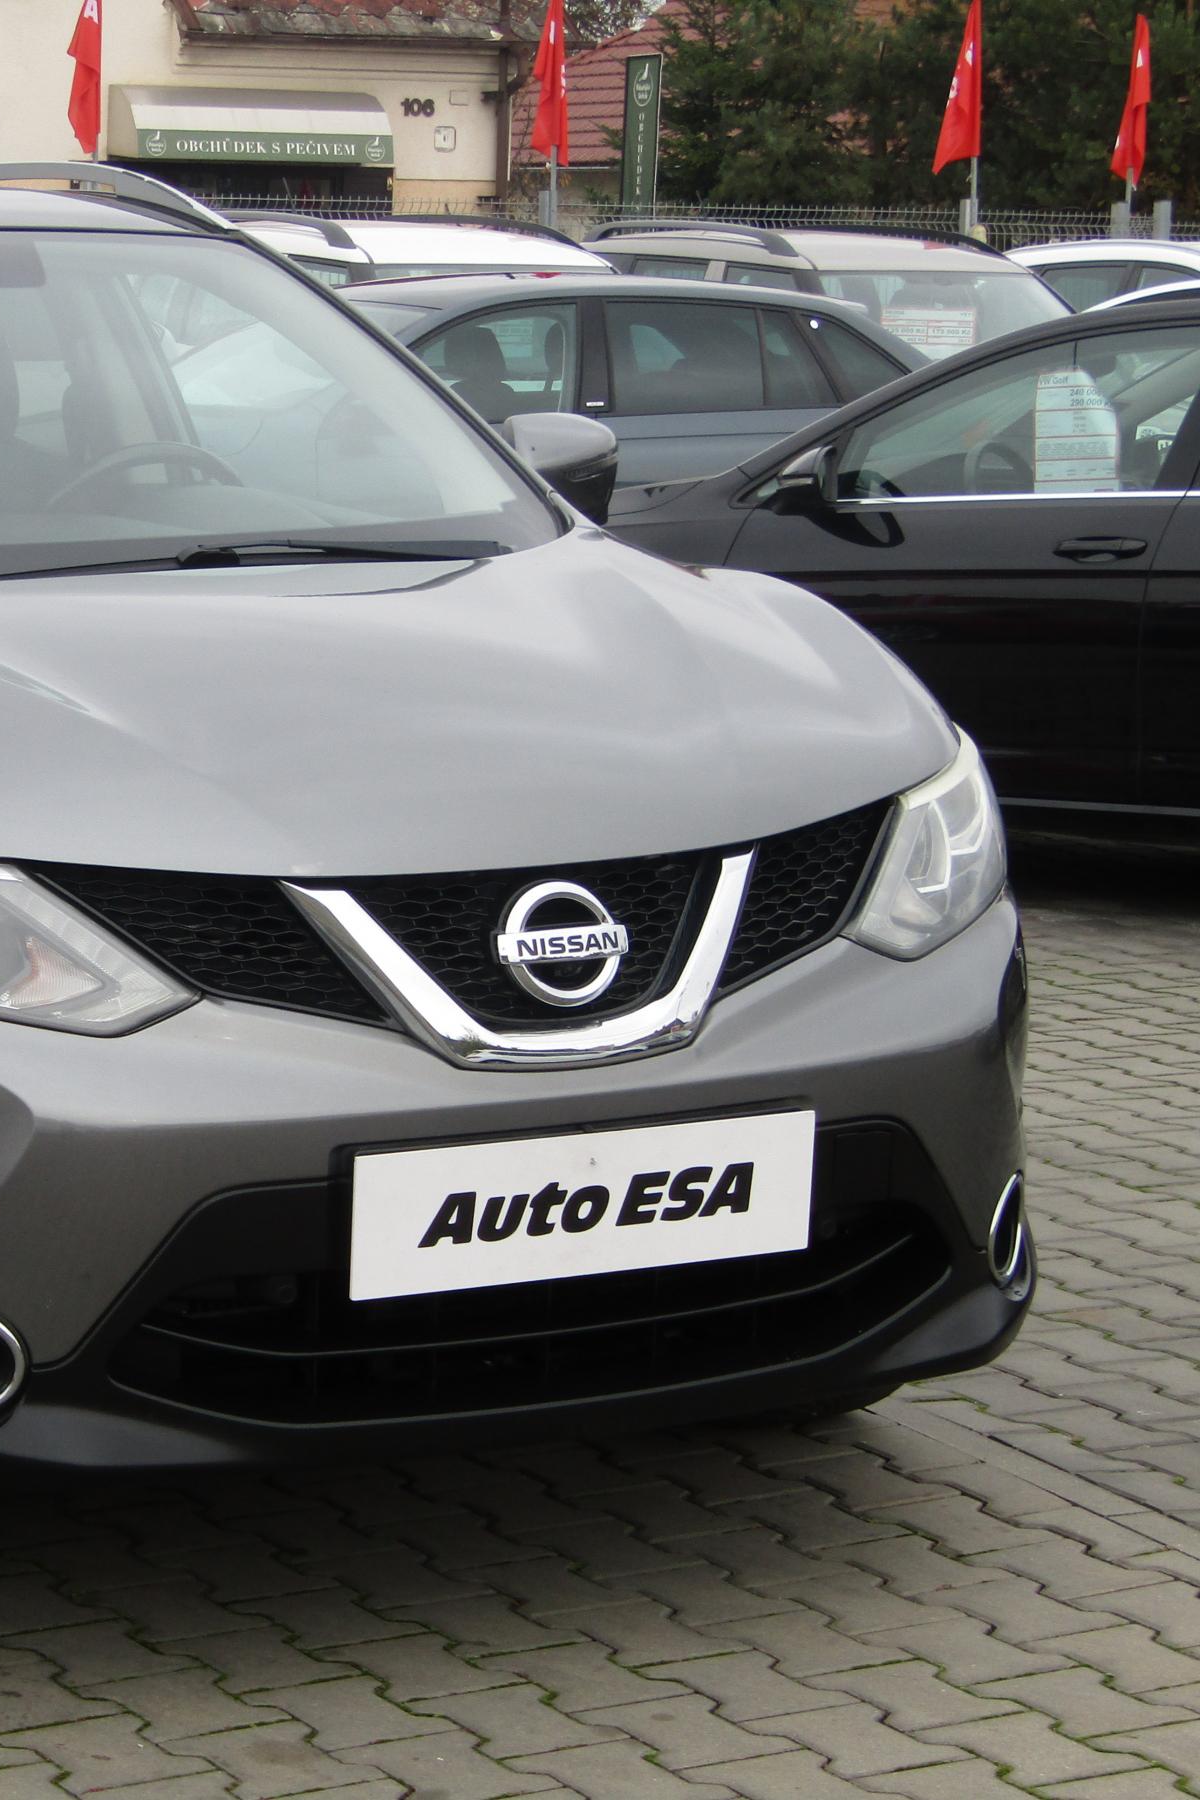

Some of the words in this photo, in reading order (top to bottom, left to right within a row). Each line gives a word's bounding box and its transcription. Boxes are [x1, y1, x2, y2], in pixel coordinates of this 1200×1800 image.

[401, 98, 435, 117] 106
[271, 142, 281, 154] S
[286, 140, 356, 156] PEČIVEM
[1052, 375, 1068, 385] Golf
[516, 931, 619, 957] NISSAN
[417, 1182, 610, 1248] Auto
[615, 1161, 754, 1227] ESA
